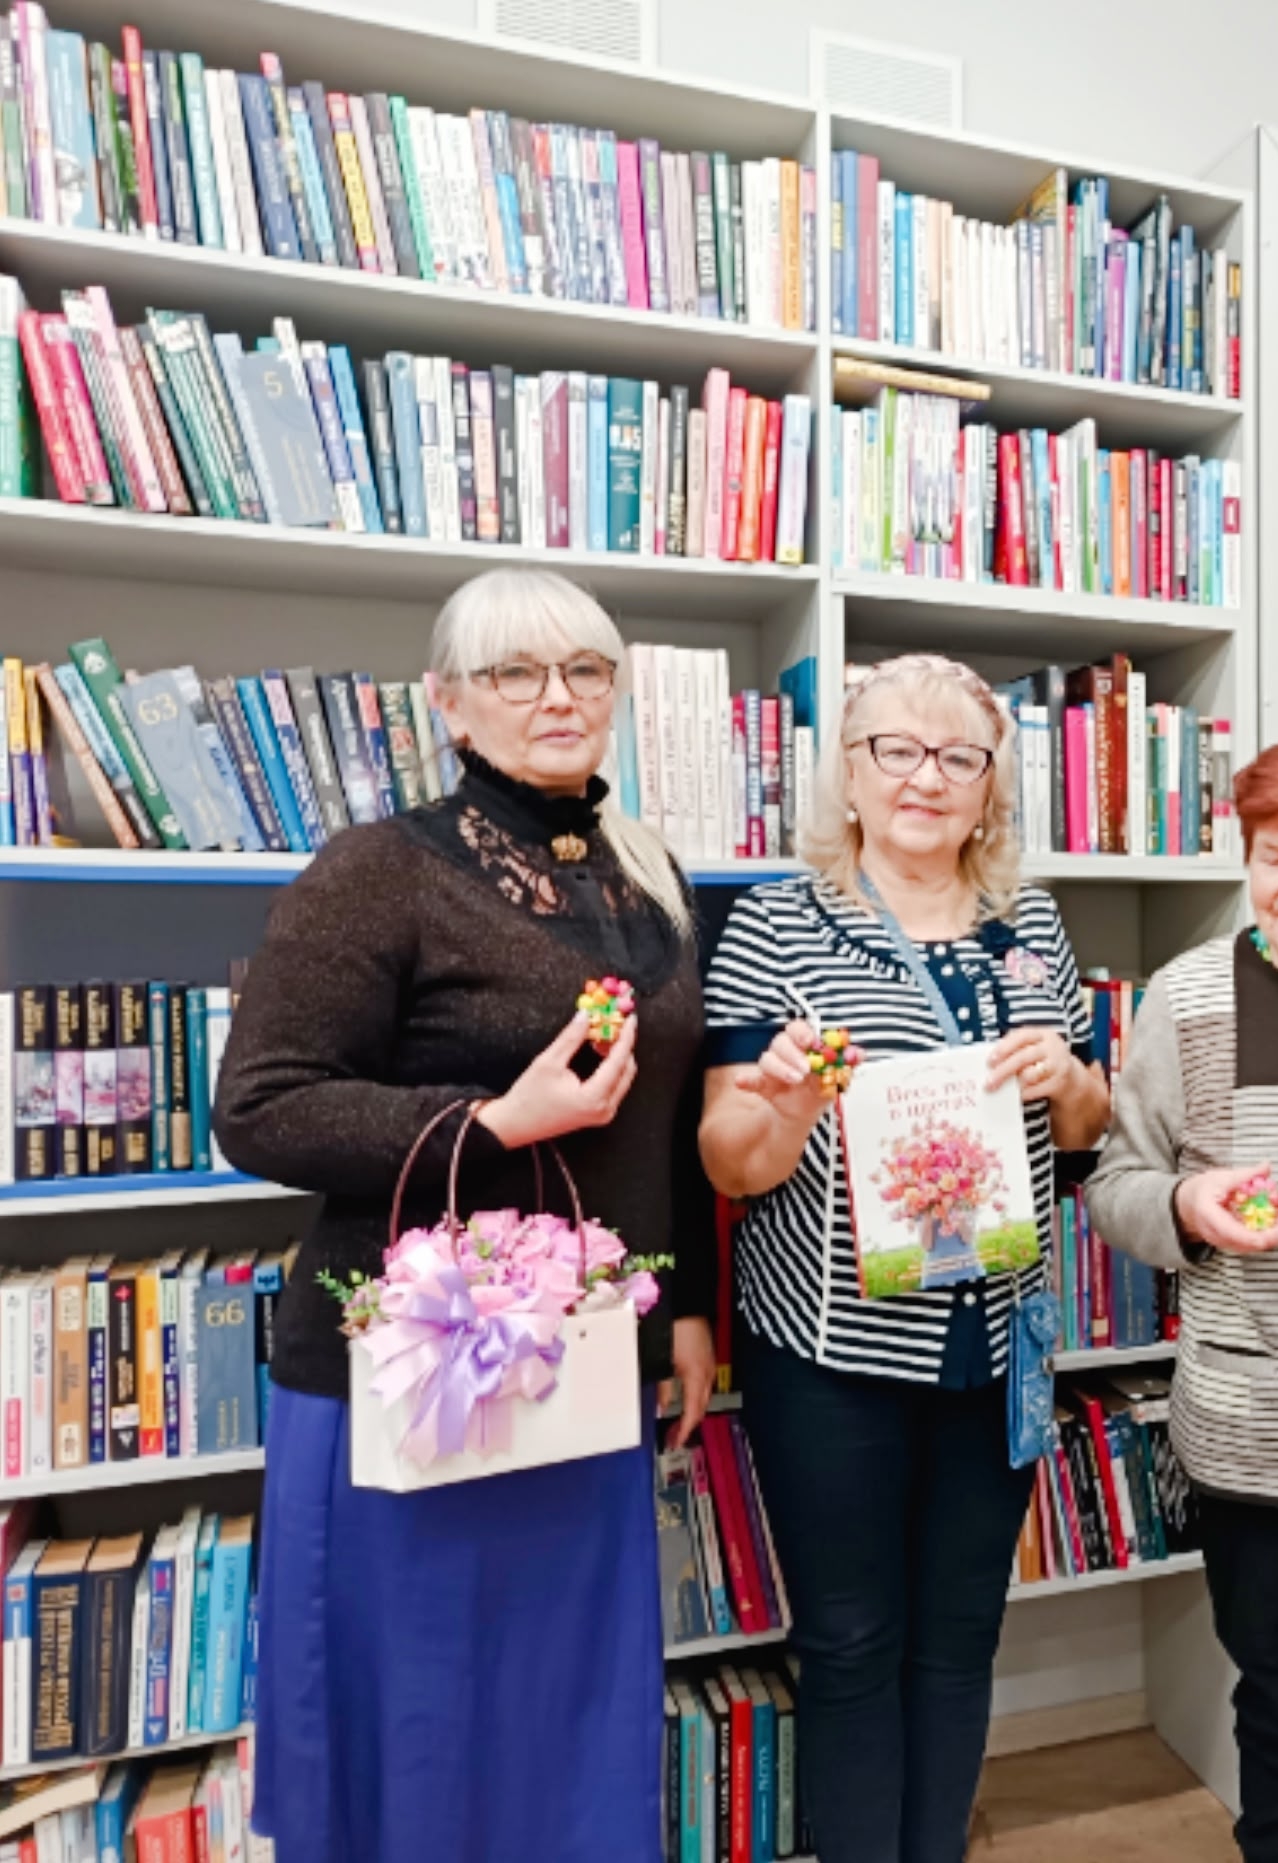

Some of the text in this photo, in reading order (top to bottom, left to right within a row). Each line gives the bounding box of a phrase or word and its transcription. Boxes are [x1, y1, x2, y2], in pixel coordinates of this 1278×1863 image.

[263, 371, 282, 400] 5
[137, 691, 179, 727] 63
[204, 1299, 246, 1328] 66
